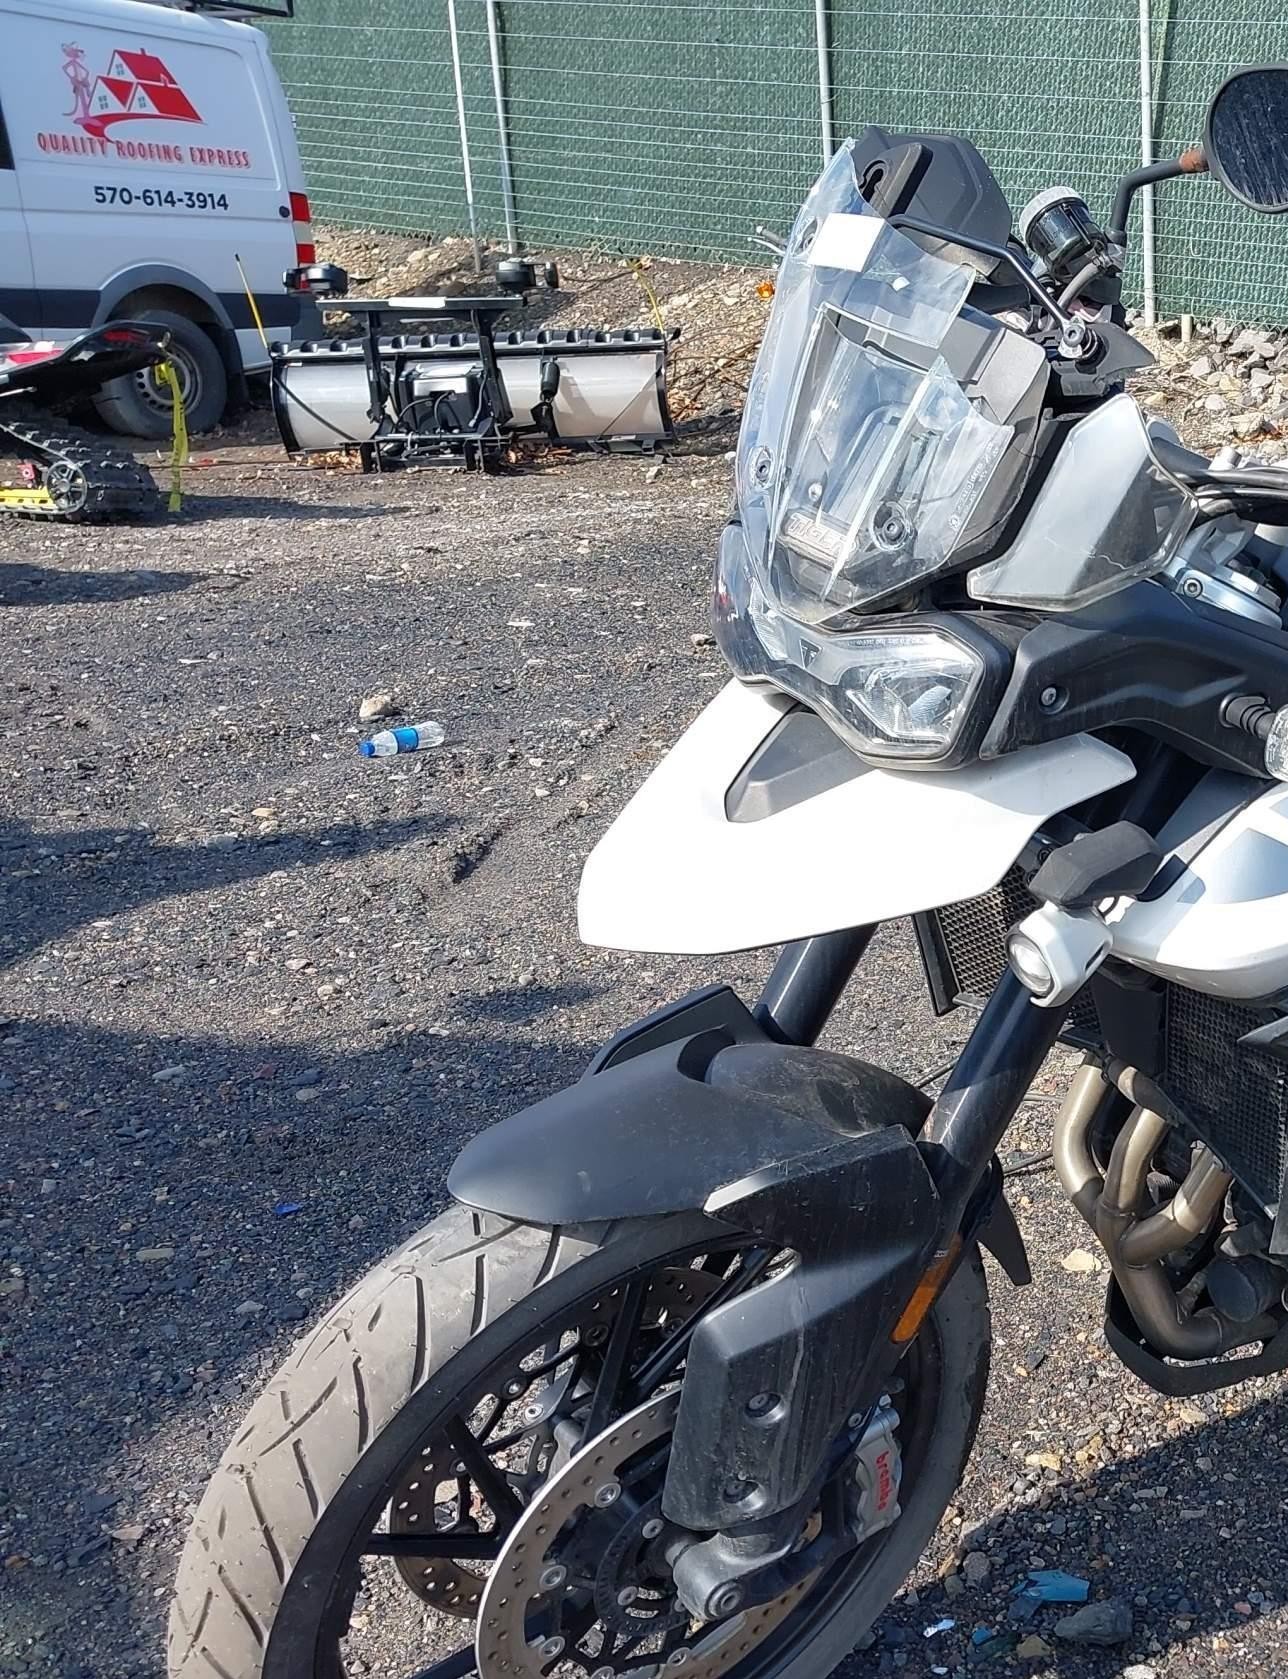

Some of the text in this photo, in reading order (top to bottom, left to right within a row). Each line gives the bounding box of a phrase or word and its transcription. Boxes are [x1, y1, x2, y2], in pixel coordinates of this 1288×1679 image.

[36, 132, 250, 168] QUALITY ROOFING EXPRESS
[94, 187, 229, 210] 570-614-3914
[876, 1450, 890, 1511] brembo
